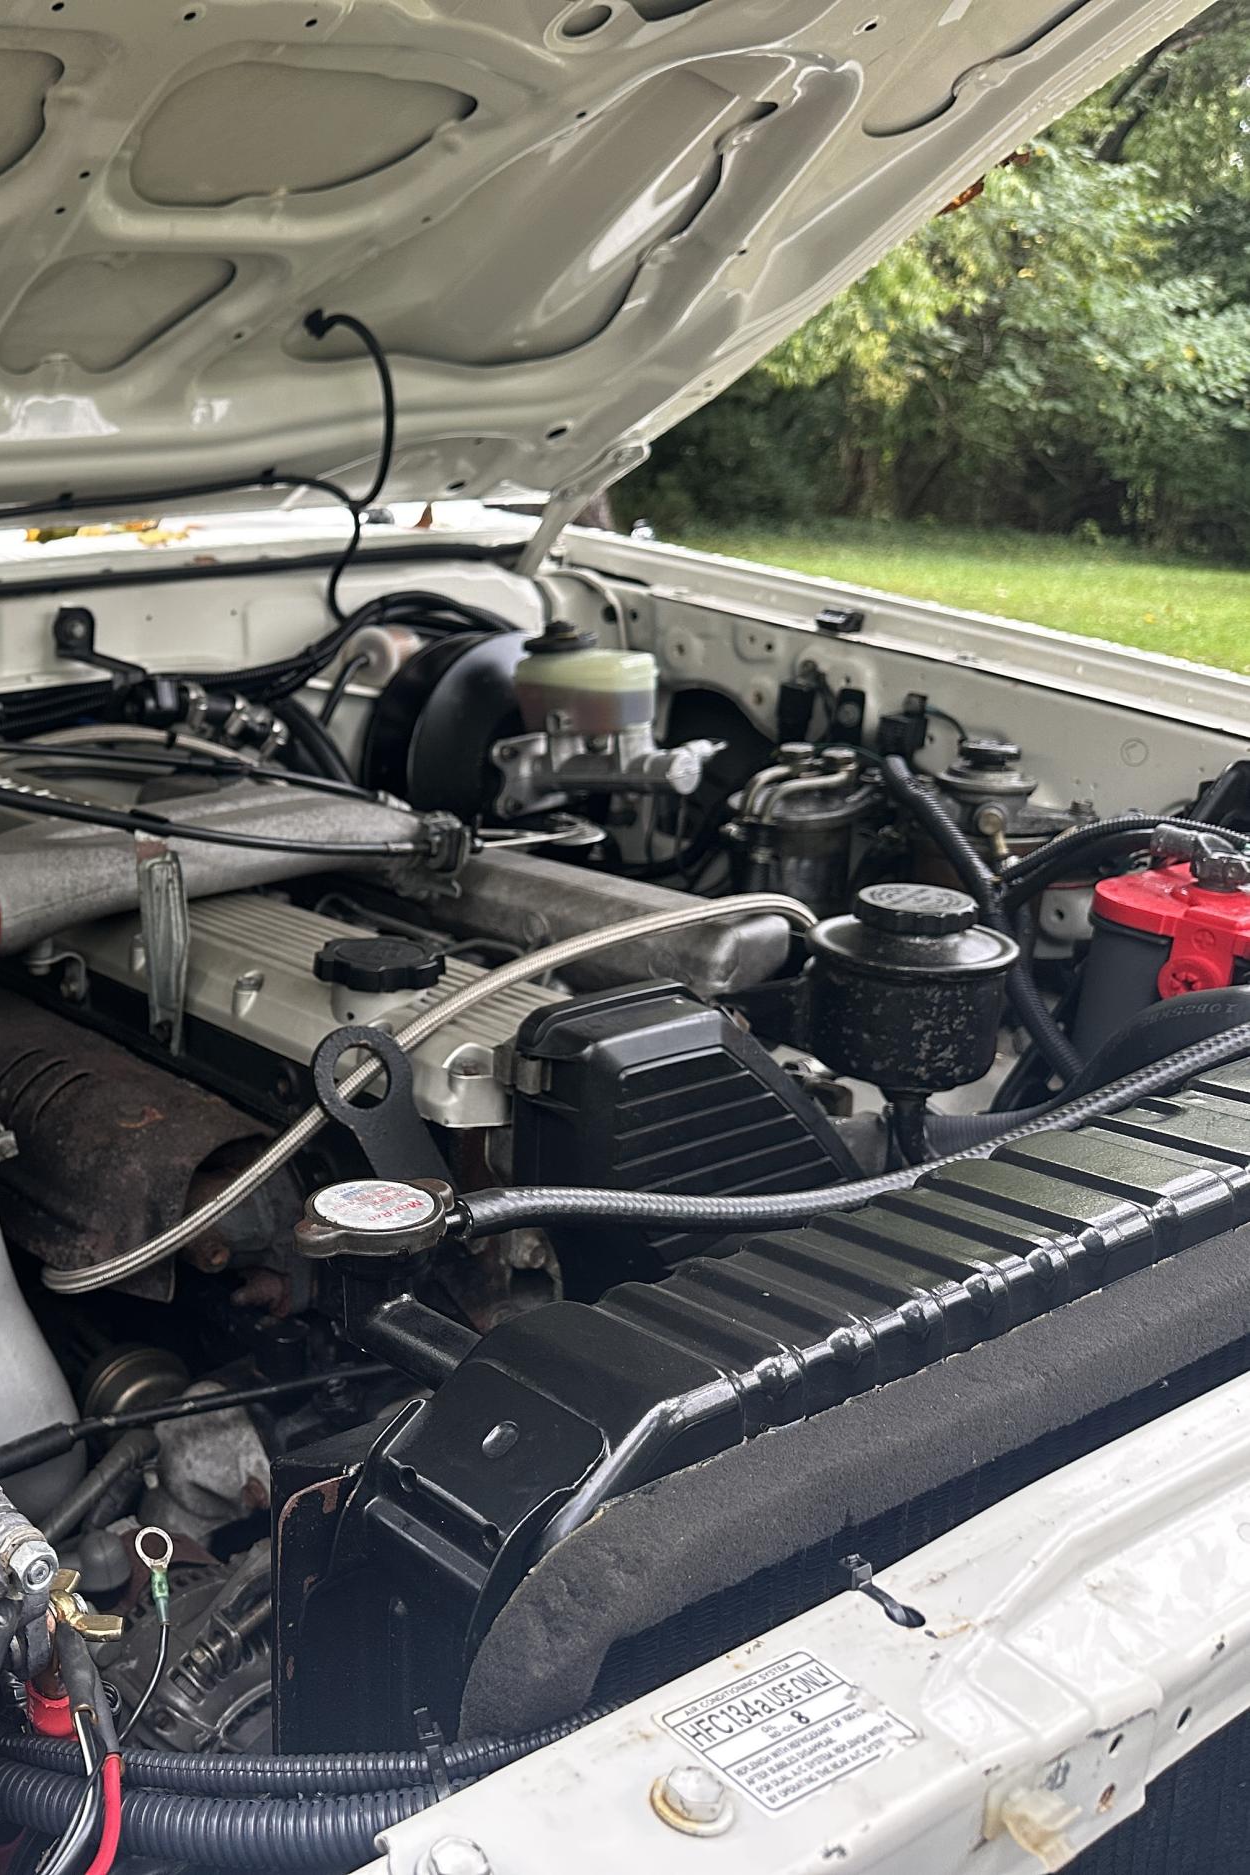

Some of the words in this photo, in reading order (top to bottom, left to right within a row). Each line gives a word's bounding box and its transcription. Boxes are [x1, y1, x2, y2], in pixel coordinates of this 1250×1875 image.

[680, 1698, 776, 1747] HFC134a
[762, 1683, 802, 1707] USE
[790, 1666, 832, 1694] ONLY
[684, 1706, 700, 1717] AIR
[700, 1678, 758, 1708] CONDITIONING
[758, 1662, 790, 1680] SYSTEM
[790, 1710, 810, 1724] 8
[746, 1771, 769, 1786] AFTER
[768, 1756, 800, 1774] BUBBLES
[816, 1766, 833, 1778] THE
[863, 1738, 886, 1754] SYSTE
[756, 1783, 772, 1794] FOR
[770, 1774, 792, 1788] DUAL
